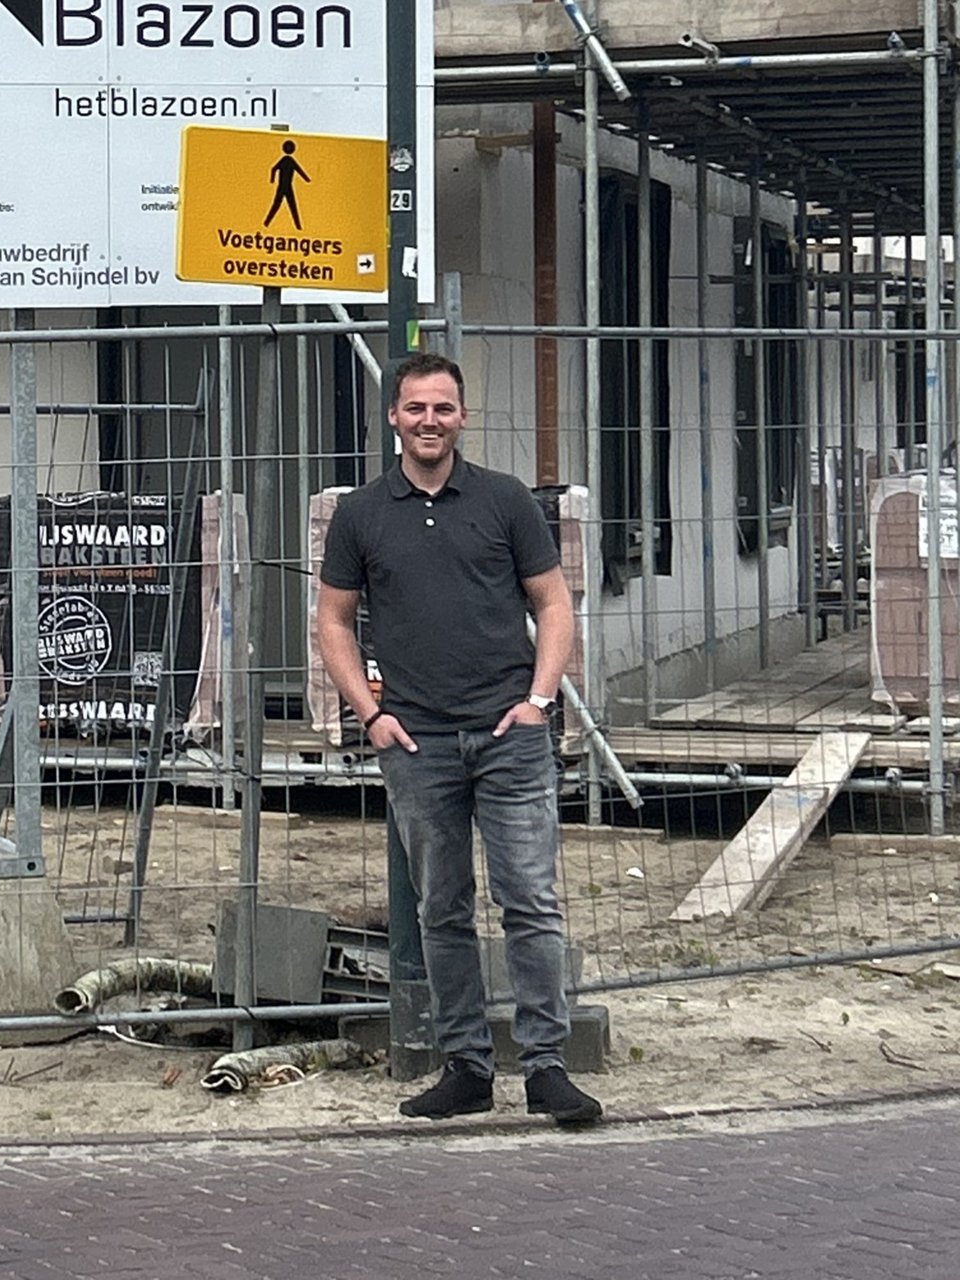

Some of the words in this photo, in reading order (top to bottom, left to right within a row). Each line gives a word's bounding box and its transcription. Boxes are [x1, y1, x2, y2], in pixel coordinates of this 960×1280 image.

[55, 88, 278, 118] hetblazoen.nl
[141, 184, 180, 195] Initiatie
[392, 193, 410, 209] 29
[218, 228, 343, 257] Voetgangers
[31, 267, 128, 290] Schijndel
[134, 266, 160, 285] bv
[223, 258, 334, 281] oversteken
[39, 524, 167, 546] IJSWAARD
